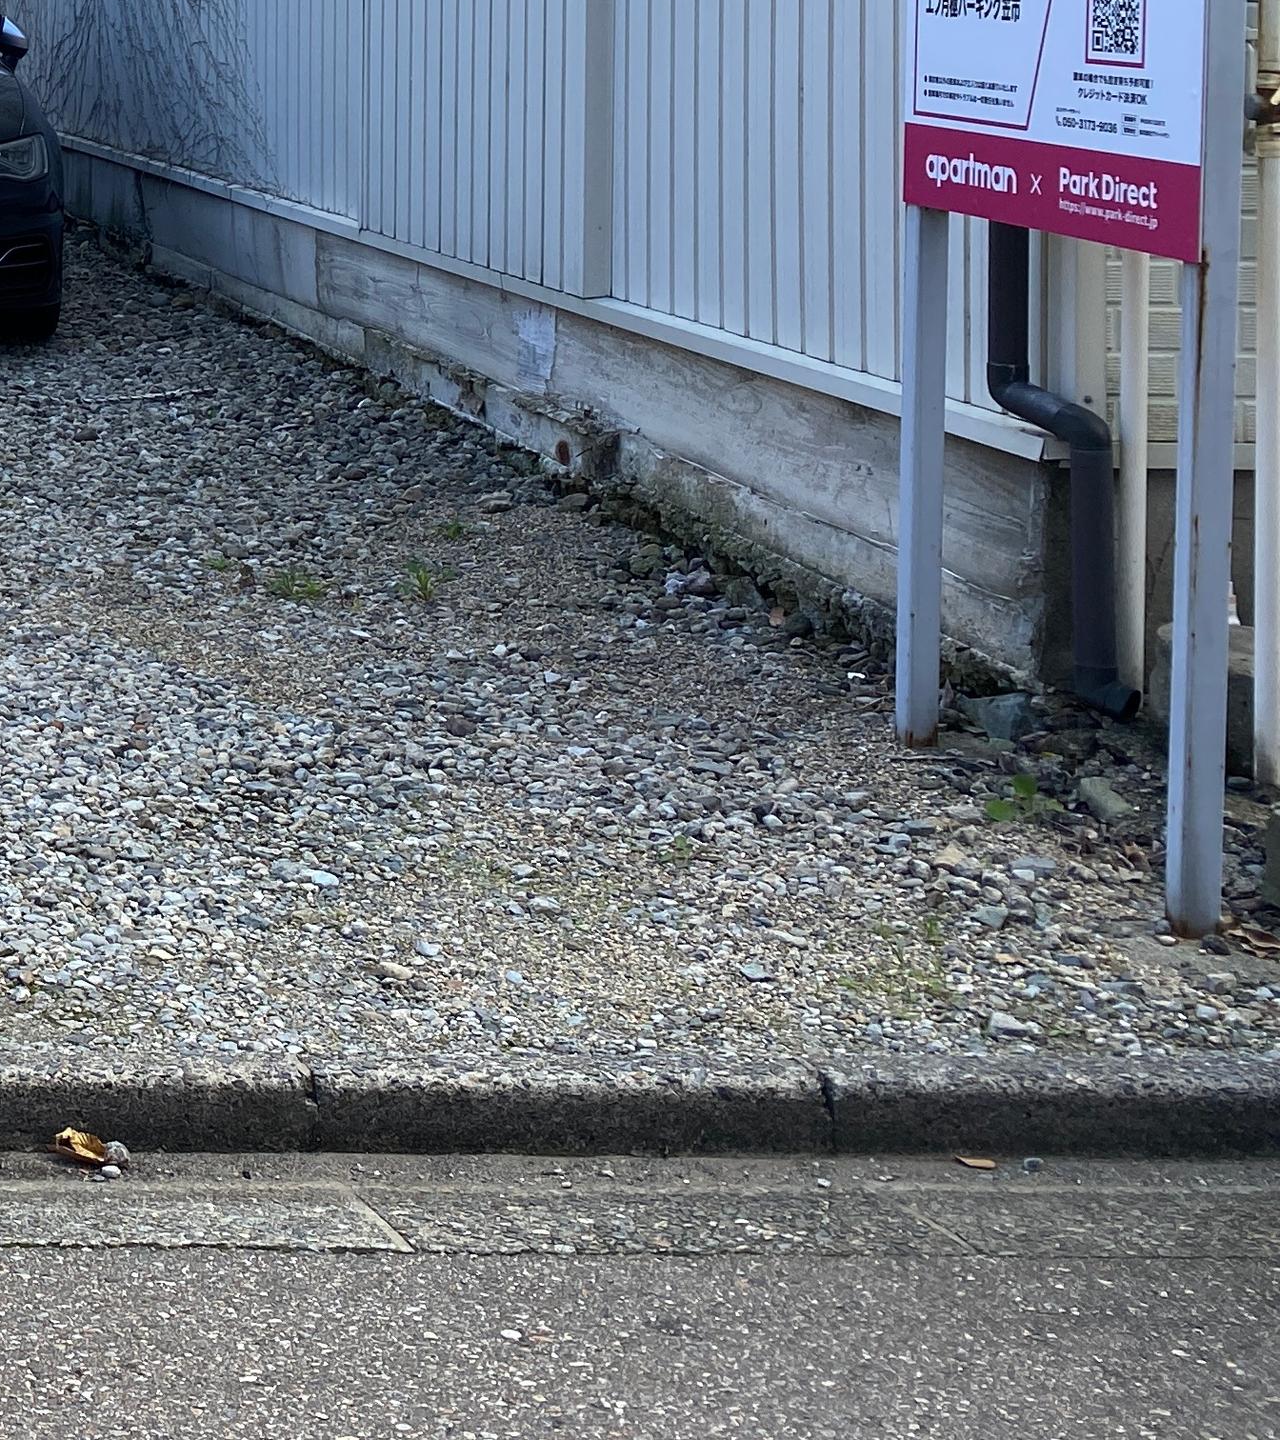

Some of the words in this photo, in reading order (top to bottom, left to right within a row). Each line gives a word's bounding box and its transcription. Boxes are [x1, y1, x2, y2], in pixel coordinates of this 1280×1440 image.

[926, 153, 1017, 194] apartman
[1059, 167, 1099, 198] Park
[1101, 174, 1157, 209] Direct
